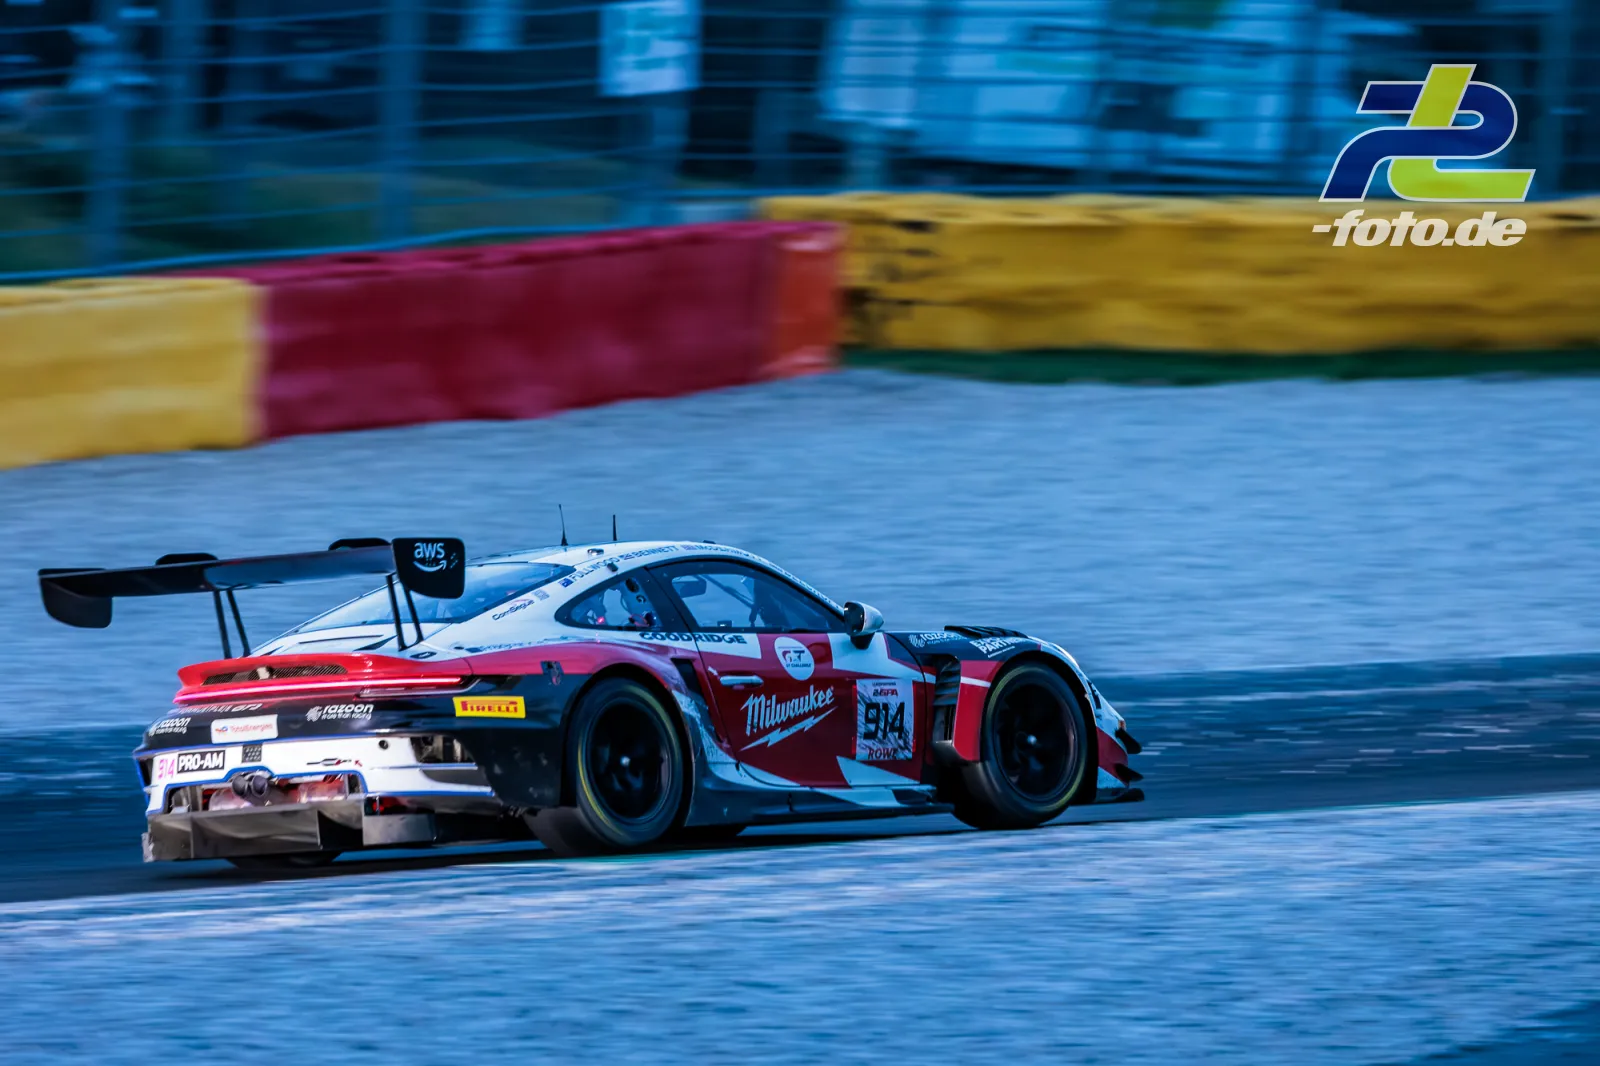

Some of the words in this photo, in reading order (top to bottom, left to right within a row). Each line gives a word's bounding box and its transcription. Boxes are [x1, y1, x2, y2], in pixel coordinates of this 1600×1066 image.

[413, 542, 446, 559] aws
[634, 545, 679, 558] BENNETT
[638, 632, 748, 645] GOODRIDGE
[321, 703, 375, 715] razoon
[460, 700, 519, 714] PIRELLI
[740, 684, 835, 736] Milwaukee
[862, 702, 905, 740] 914
[178, 751, 224, 772] PRO-AM
